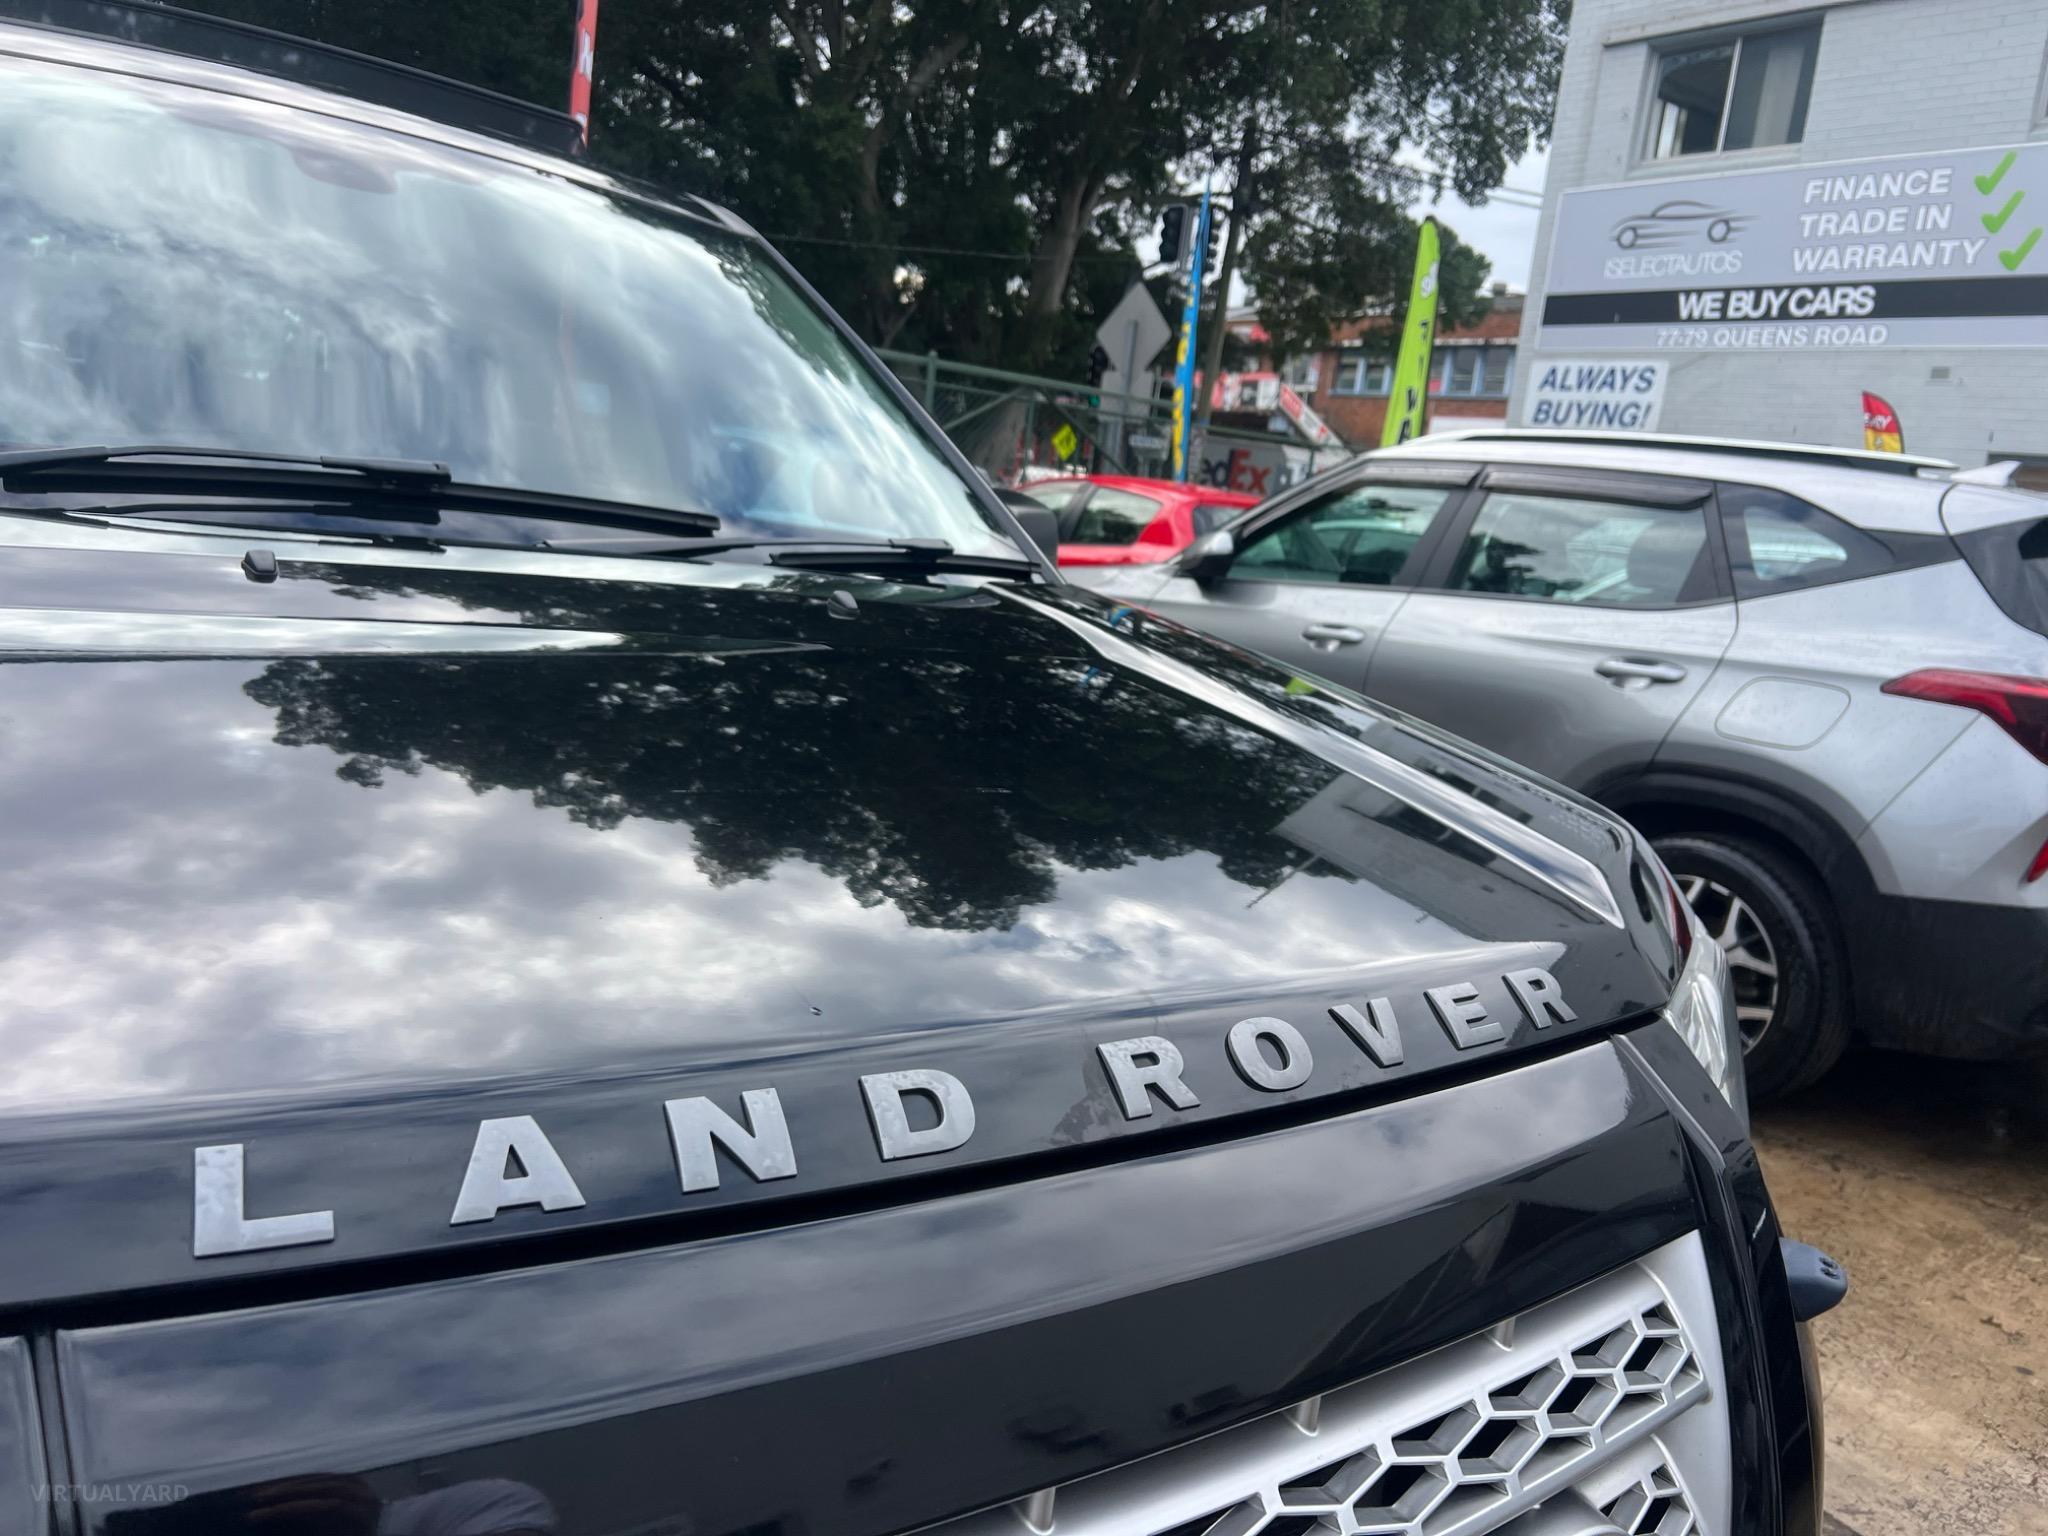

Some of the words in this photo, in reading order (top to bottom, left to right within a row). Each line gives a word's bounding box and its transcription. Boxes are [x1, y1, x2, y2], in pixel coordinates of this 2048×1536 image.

[1804, 168, 1953, 204] FINANCE
[1800, 206, 1909, 239] TRADE
[1915, 203, 1952, 232] IN
[1792, 238, 1988, 273] WARRANTY
[1678, 291, 1725, 320] WE
[1727, 286, 1788, 319] BUY
[1788, 285, 1876, 317] CARS
[1712, 325, 1809, 348] QUEENS
[1813, 323, 1889, 346] ROAD
[1537, 365, 1656, 394] ALWAYS
[1531, 399, 1653, 429] BUYING!
[193, 1068, 976, 1258] LAND
[1098, 967, 1578, 1121] ROVER
